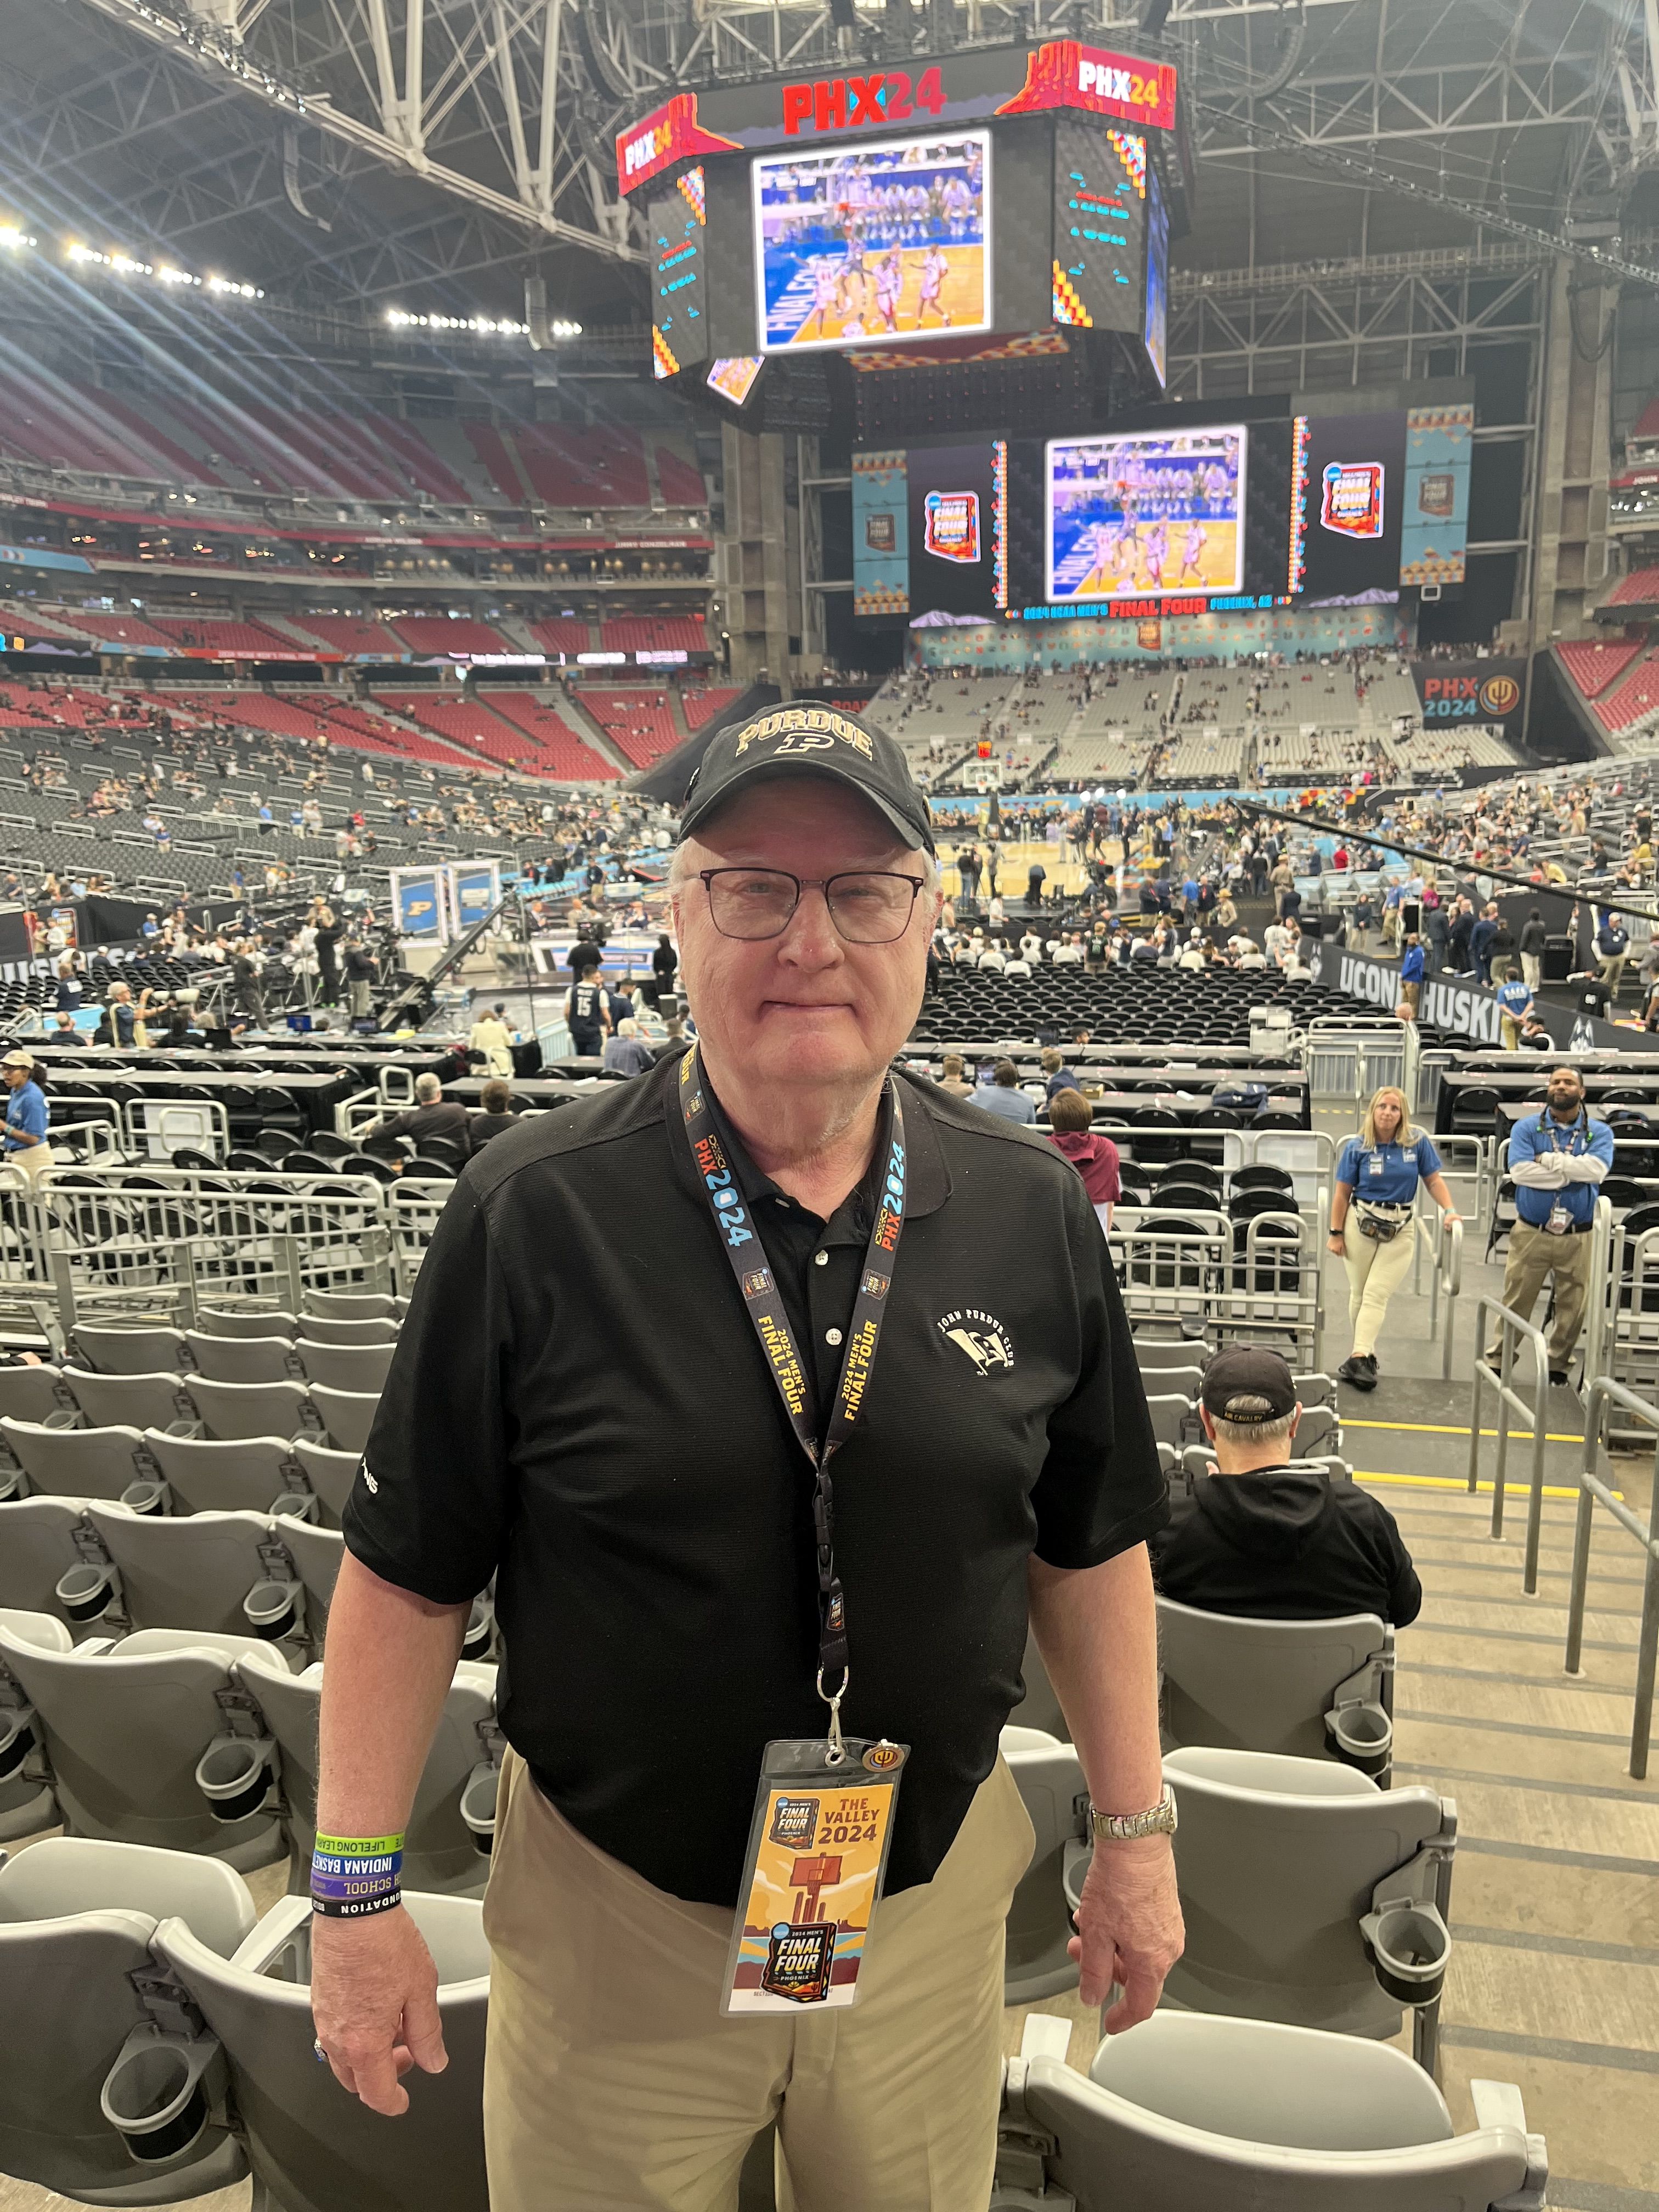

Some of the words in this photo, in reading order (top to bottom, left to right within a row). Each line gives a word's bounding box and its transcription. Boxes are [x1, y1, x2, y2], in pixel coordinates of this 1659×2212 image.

[1078, 61, 1160, 109] PHX24
[782, 66, 947, 135] PHX24
[625, 120, 673, 175] PHX24
[1109, 600, 1158, 619] FINAL
[1161, 597, 1207, 615] FOUR
[1424, 677, 1477, 699] PHX
[1424, 698, 1477, 717] 2024
[736, 709, 873, 761] PURDUE
[577, 996, 591, 1016] 15
[937, 1311, 962, 1333] JOHN
[966, 1309, 1003, 1334] PURDUE
[758, 1316, 785, 1366] FINAL
[778, 1367, 803, 1415] FOUR
[777, 1329, 791, 1358] 2024
[788, 1359, 806, 1395] MEN'S
[842, 1370, 854, 1400] 2024
[848, 1333, 862, 1369] MEN'S
[844, 1371, 867, 1421] FINAL
[857, 1321, 877, 1367] FOUR
[780, 1808, 809, 1819] FINAL
[840, 1798, 868, 1811] THE
[777, 1818, 808, 1830] FOUR
[825, 1809, 879, 1824] VALLEY
[818, 1824, 877, 1844] 2024
[337, 1841, 385, 1852] LIFELONG
[345, 1857, 392, 1874] INDIANA
[344, 1877, 392, 1895] SCHOOL
[777, 1937, 822, 1955] FINAL
[774, 1954, 819, 1972] FOUR
